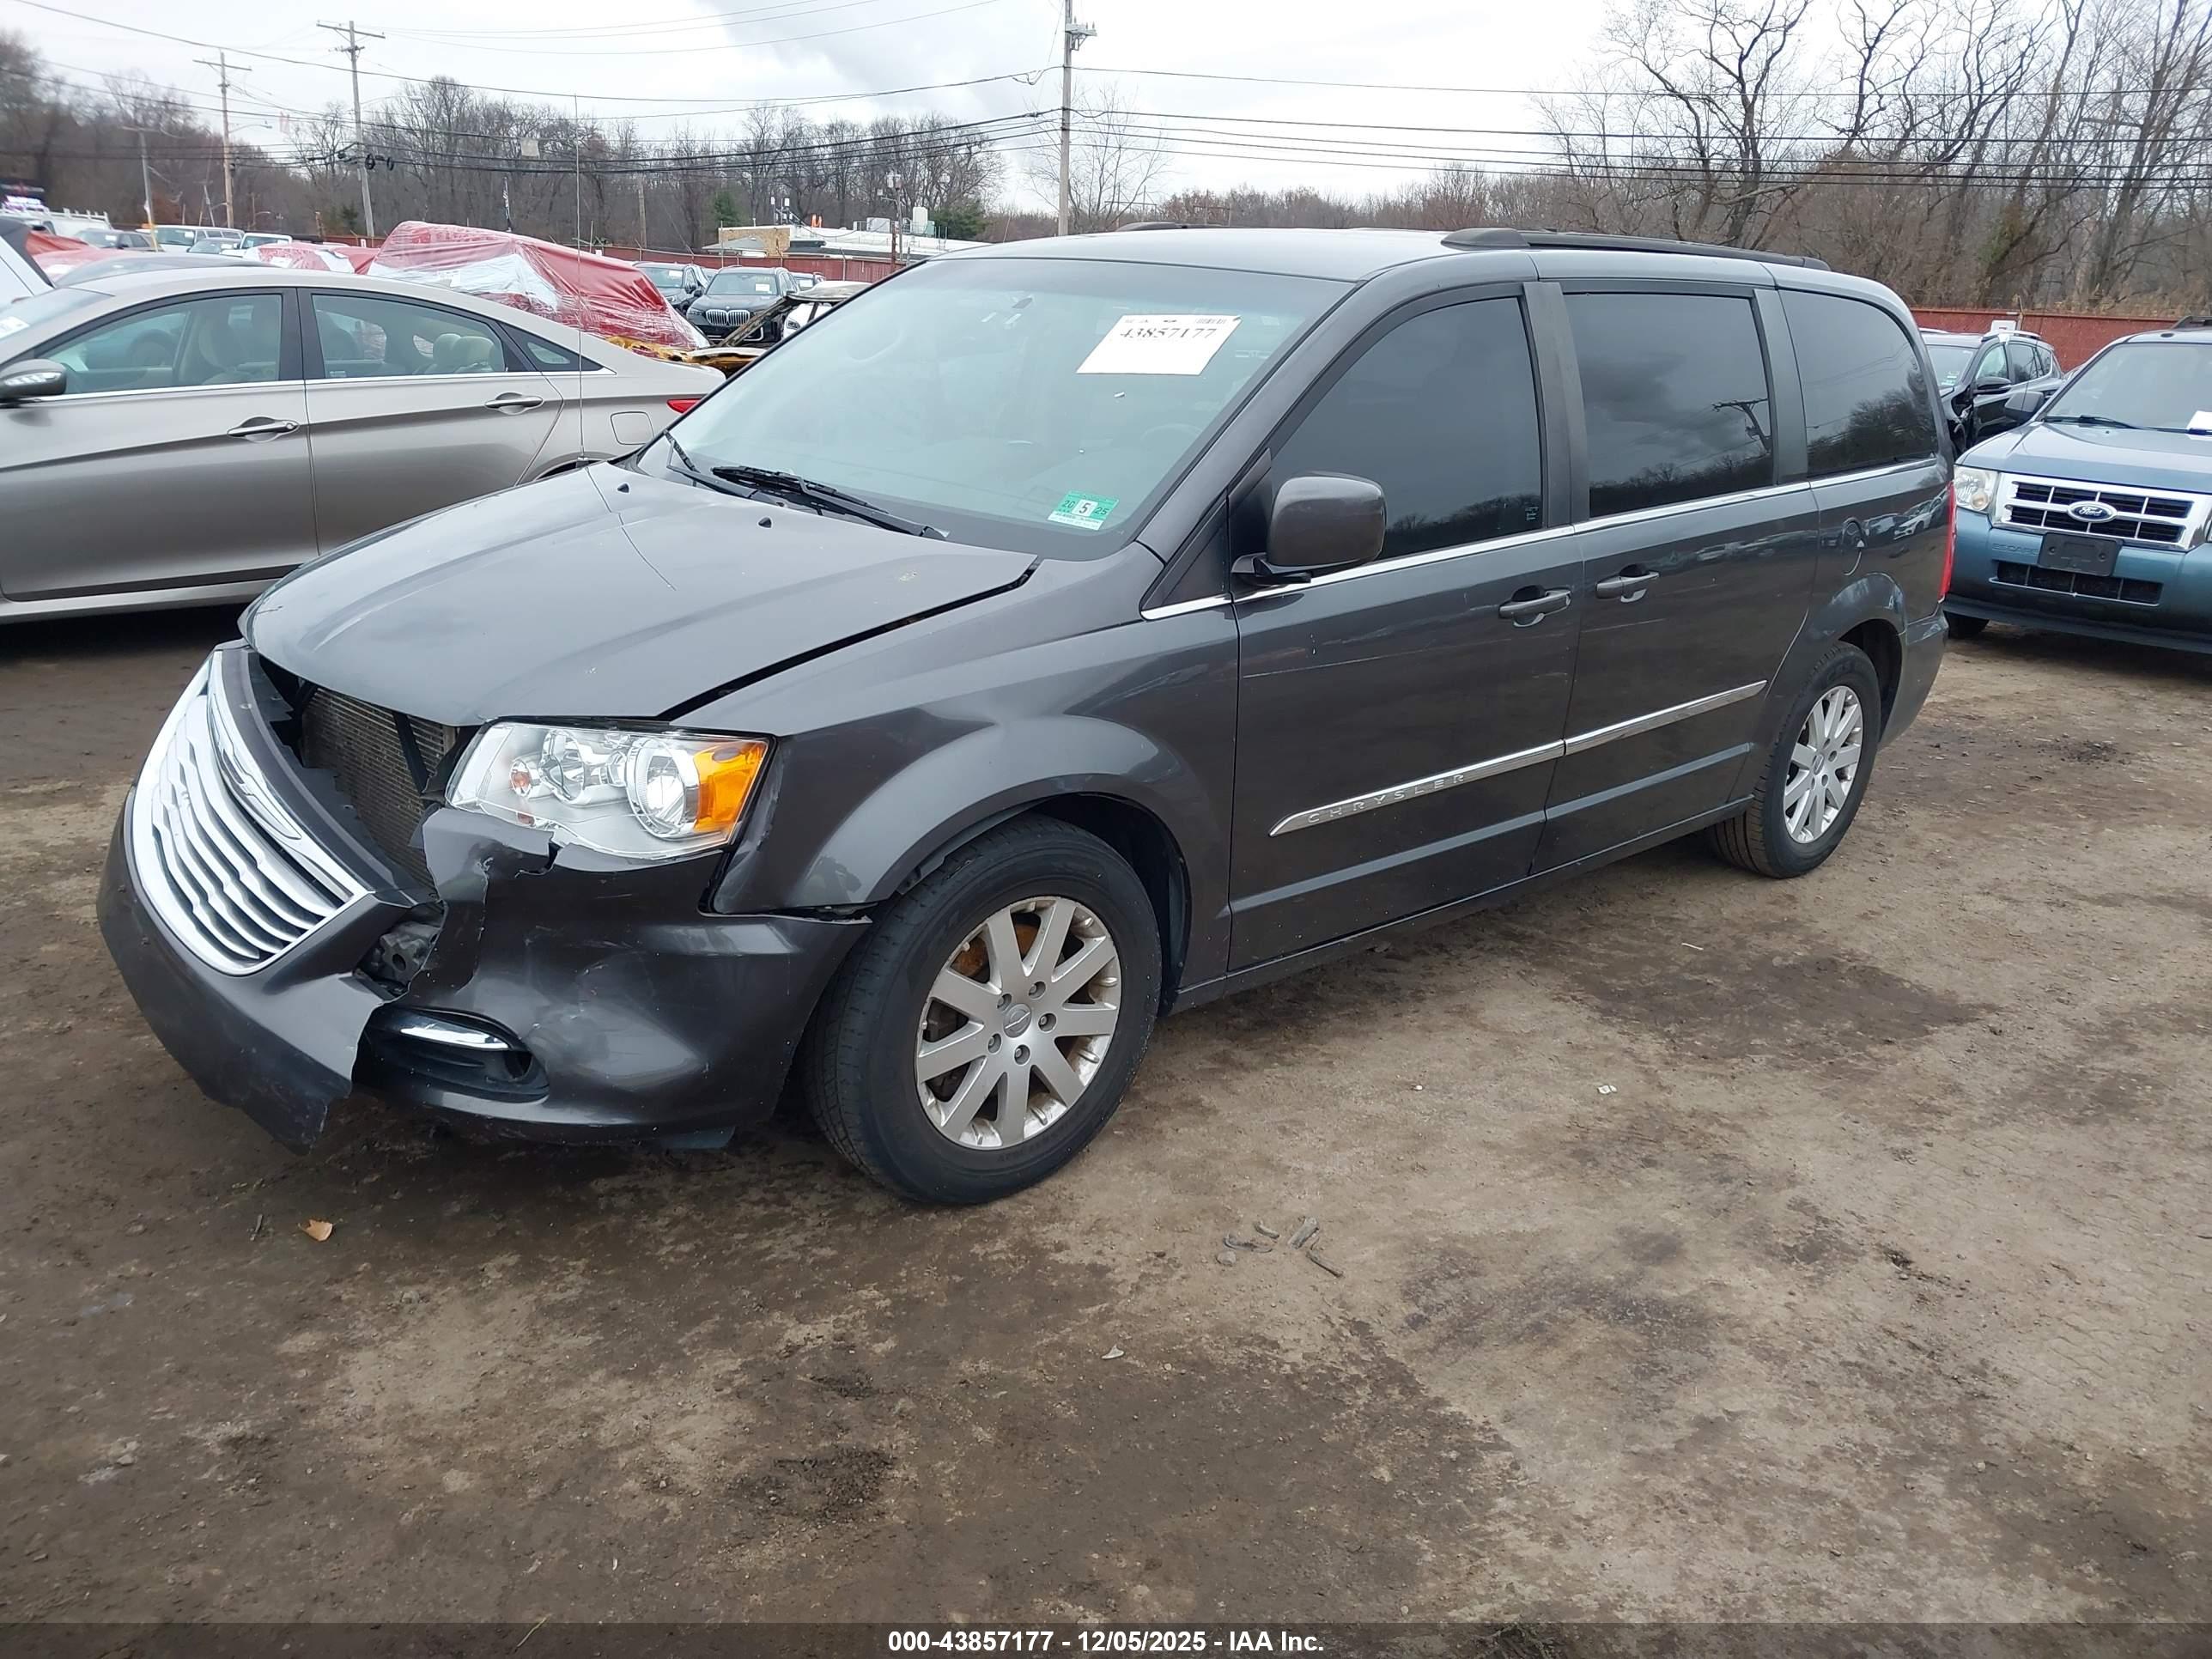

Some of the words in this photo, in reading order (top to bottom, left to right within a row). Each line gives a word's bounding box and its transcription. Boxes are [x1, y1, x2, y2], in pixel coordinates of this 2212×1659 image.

[1120, 327, 1218, 339] 43857177
[1061, 500, 1076, 508] 20
[1079, 502, 1091, 514] 5
[1095, 507, 1109, 515] 25
[1307, 774, 1465, 824] CHRYSLER
